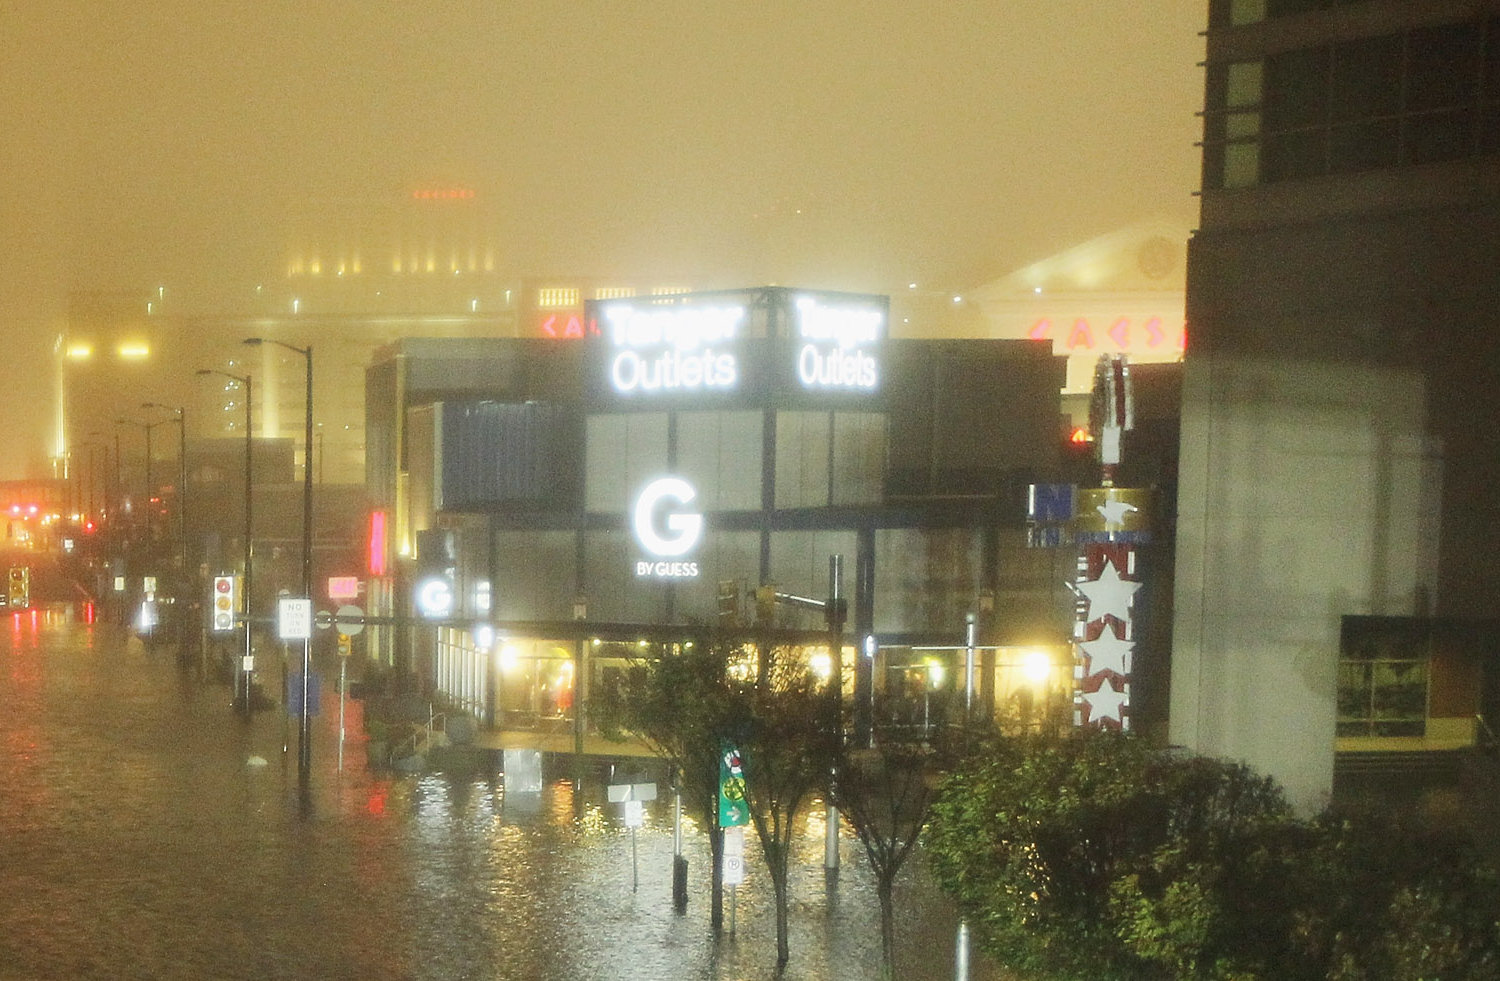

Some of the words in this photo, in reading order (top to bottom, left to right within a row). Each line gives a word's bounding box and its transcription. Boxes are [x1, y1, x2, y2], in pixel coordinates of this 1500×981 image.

[606, 306, 744, 349] Tanger
[797, 298, 882, 348] Tanger
[612, 349, 736, 391] Outlets
[799, 344, 877, 388] Outlets
[635, 478, 703, 556] G
[636, 561, 654, 577] BY
[655, 561, 700, 577] GUESS
[288, 603, 302, 611] NO
